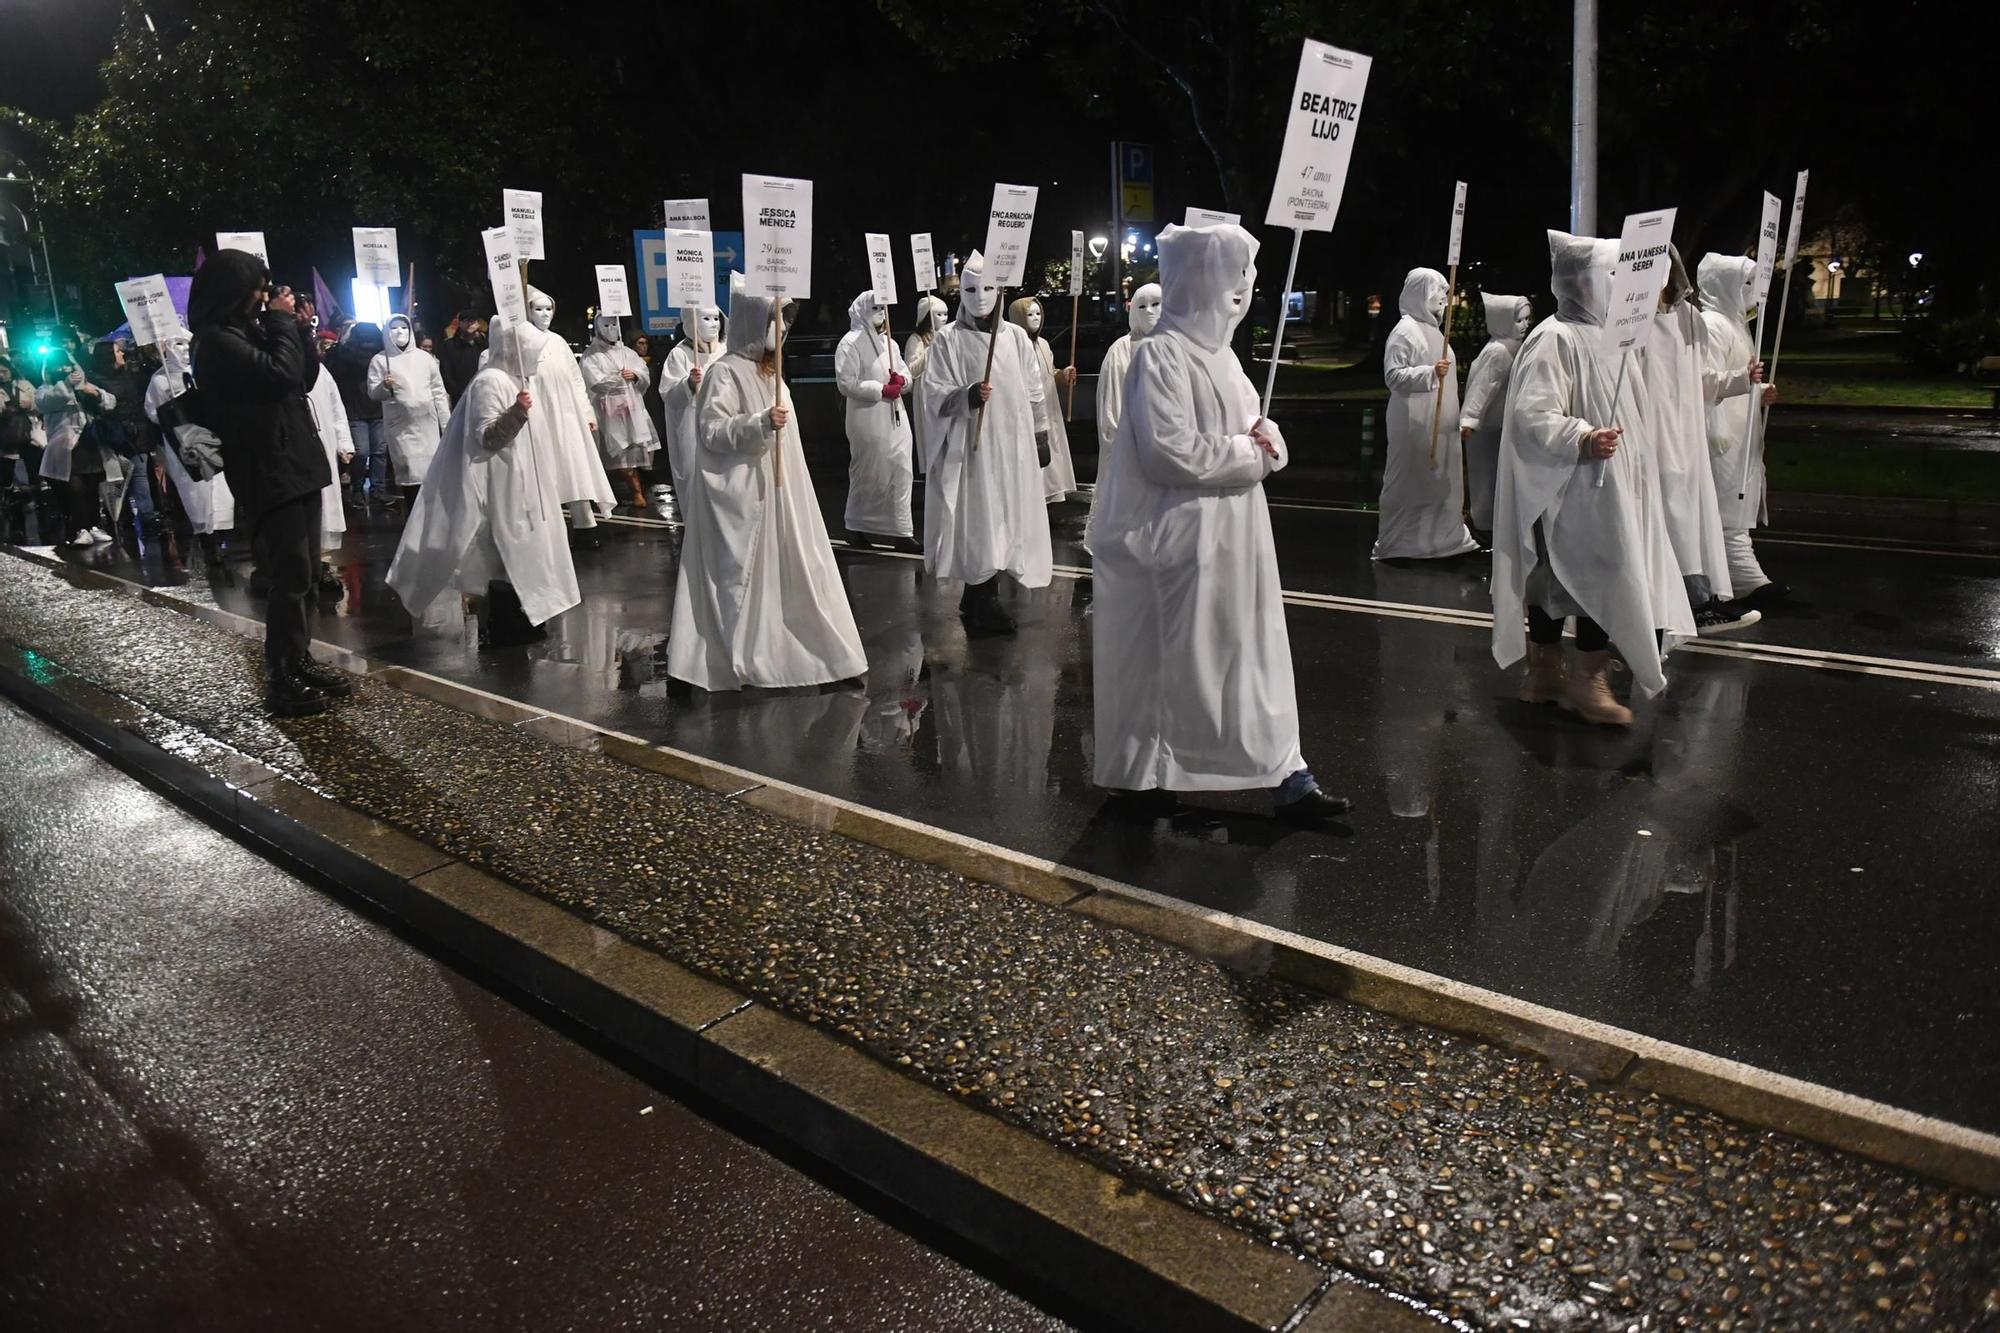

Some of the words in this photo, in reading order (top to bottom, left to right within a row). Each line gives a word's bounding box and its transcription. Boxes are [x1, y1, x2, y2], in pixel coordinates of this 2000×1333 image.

[1300, 92, 1357, 121] BEATRIZ
[1311, 118, 1340, 141] LIJO
[1131, 149, 1144, 178] P
[1301, 166, 1314, 178] 47
[759, 207, 796, 219] JESSICA
[992, 210, 1032, 220] ENCARNACIÓN
[761, 242, 773, 254] 29
[1618, 250, 1635, 263] ANA
[1637, 244, 1667, 259] VANESSA
[676, 255, 704, 263] MARCOS
